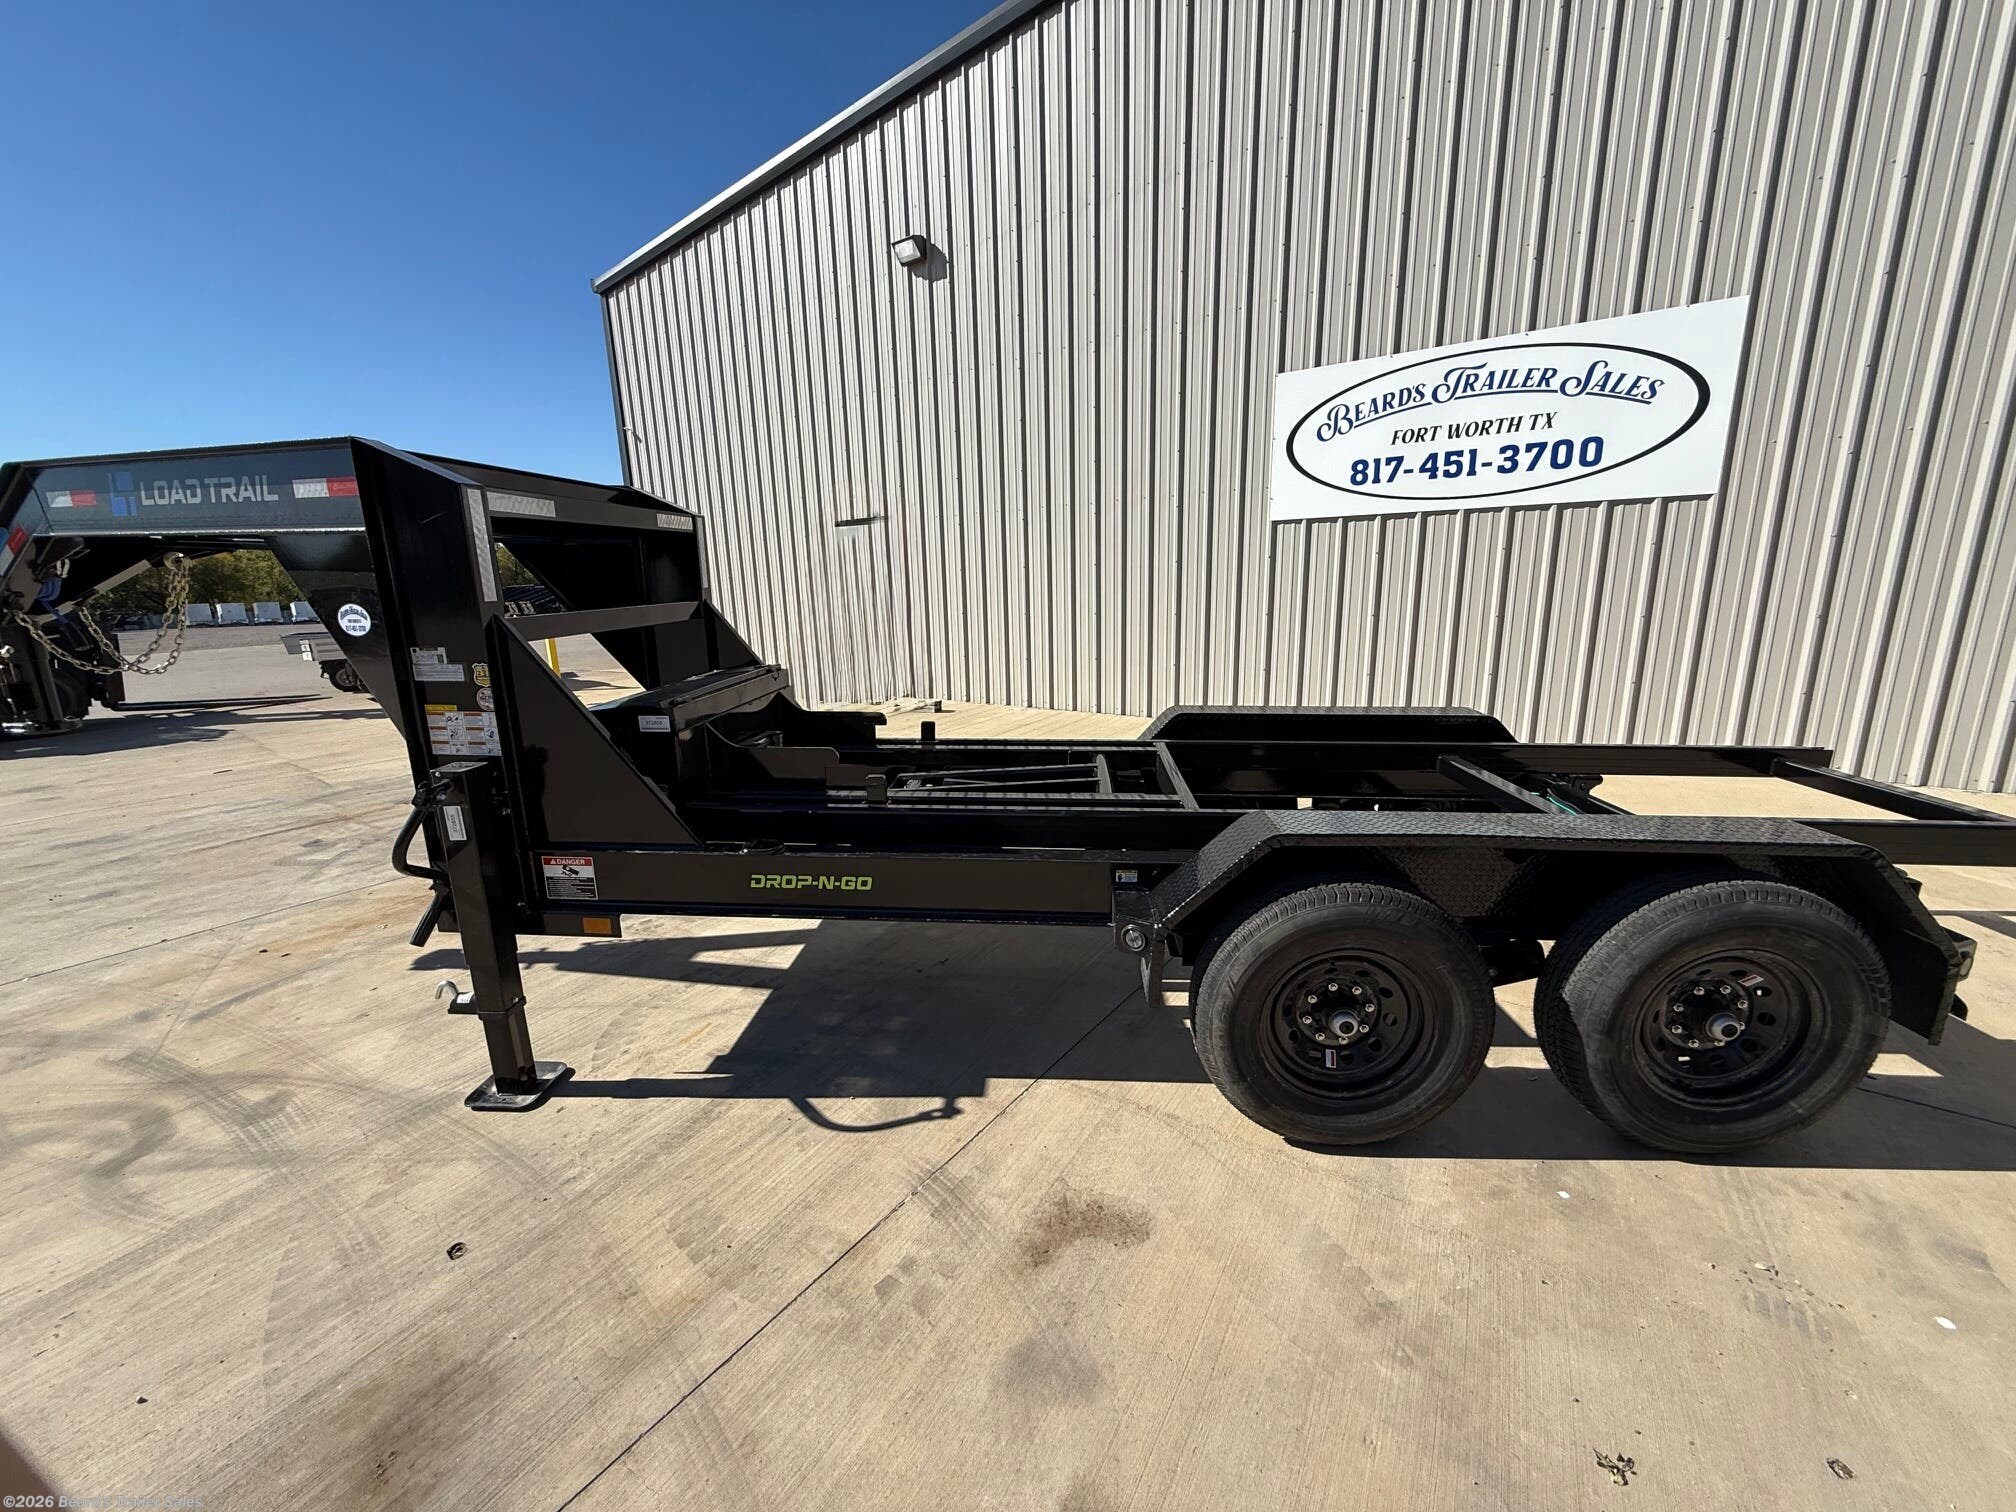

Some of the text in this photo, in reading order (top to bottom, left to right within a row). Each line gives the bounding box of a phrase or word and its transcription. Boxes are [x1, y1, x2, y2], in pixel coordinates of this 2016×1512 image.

[1317, 360, 1666, 442] BEARD'S TRAILER SALES
[1391, 412, 1558, 445] FORT WORTH TX
[1350, 436, 1604, 486] 817-451-3700
[140, 474, 279, 506] LOAD TRAIL
[750, 874, 873, 890] DROP-N-GO
